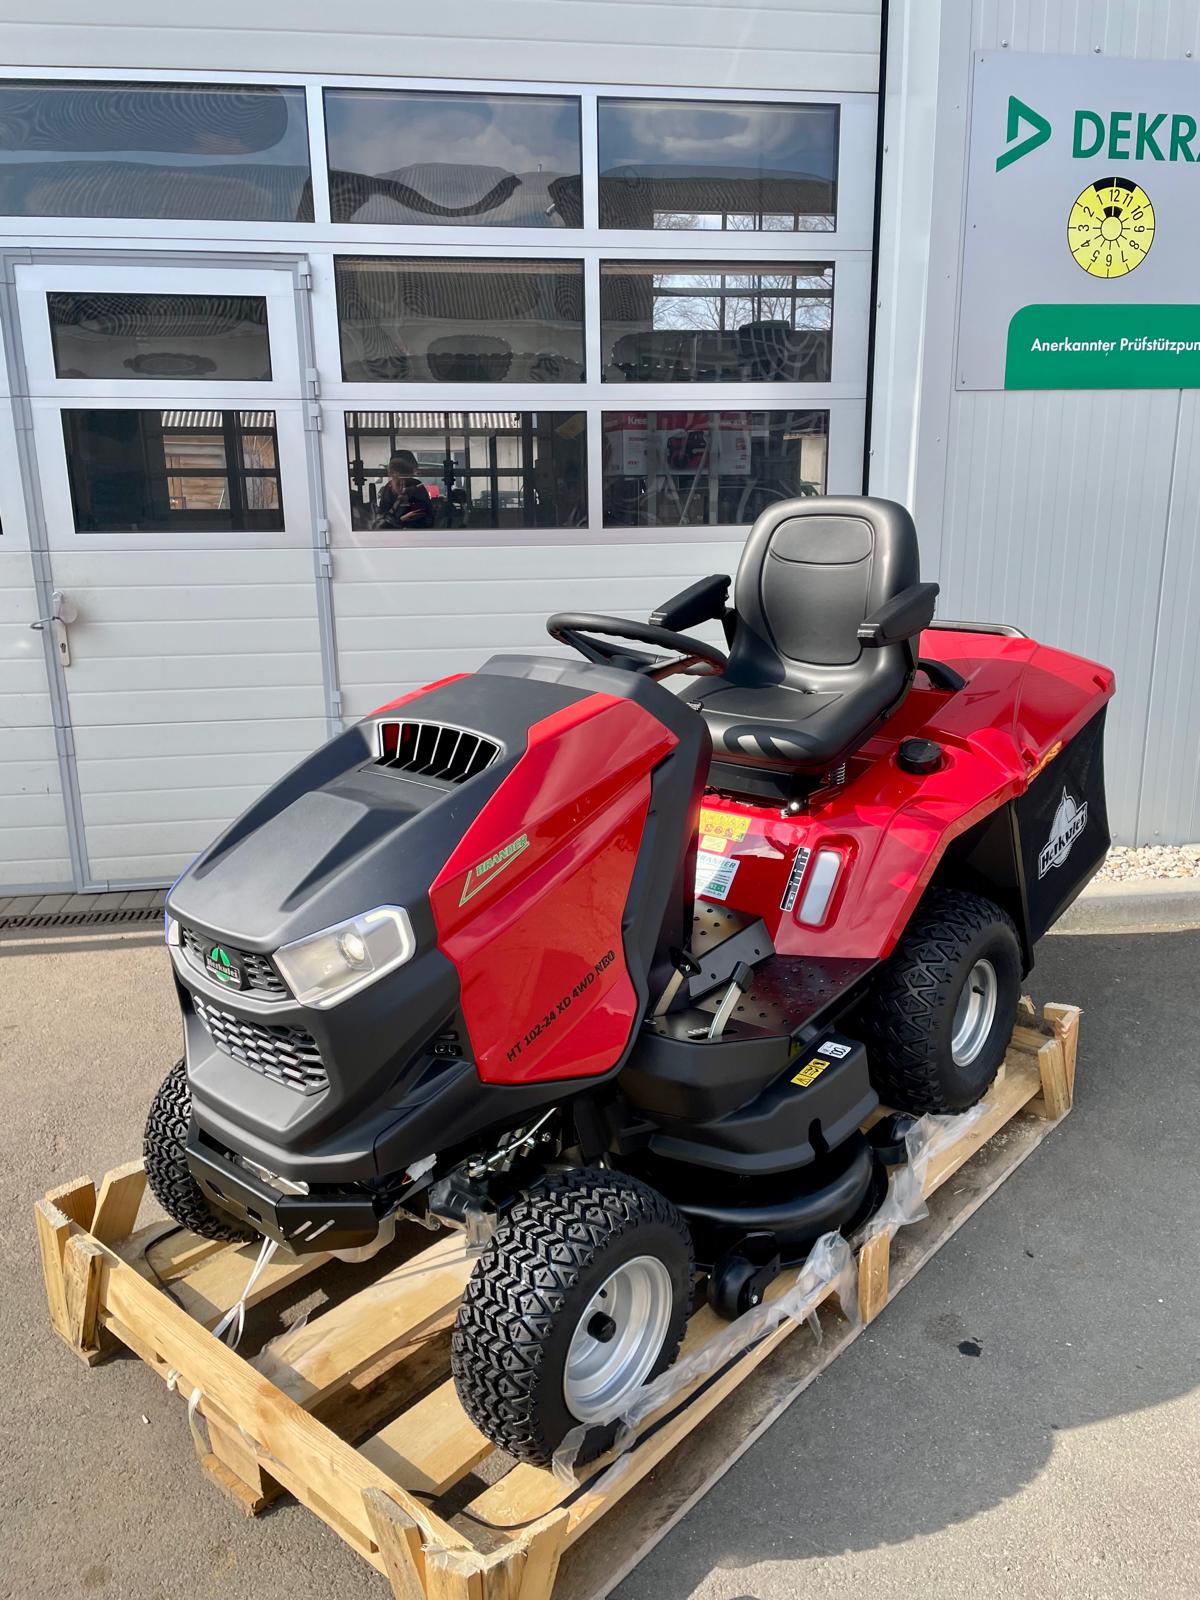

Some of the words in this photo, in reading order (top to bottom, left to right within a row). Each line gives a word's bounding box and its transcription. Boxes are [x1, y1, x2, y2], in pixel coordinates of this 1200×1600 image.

[1072, 110, 1200, 162] DEKR
[1096, 193, 1104, 205] 1
[1109, 189, 1120, 202] 12
[1122, 193, 1134, 208] 11
[1083, 206, 1094, 217] 2
[1131, 205, 1144, 221] 10
[1077, 224, 1090, 232] 3
[1133, 225, 1145, 233] 9
[1080, 240, 1091, 248] 4
[1129, 240, 1140, 250] 8
[1090, 249, 1101, 263] 5
[1105, 253, 1112, 267] 6
[1121, 250, 1128, 263] 7
[1031, 336, 1117, 352] Anerkannter
[1120, 336, 1200, 355] Prüfstützpun
[506, 1040, 522, 1062] HT
[523, 1010, 557, 1046] 102-24
[556, 996, 571, 1014] XD
[572, 972, 595, 998] 4WD
